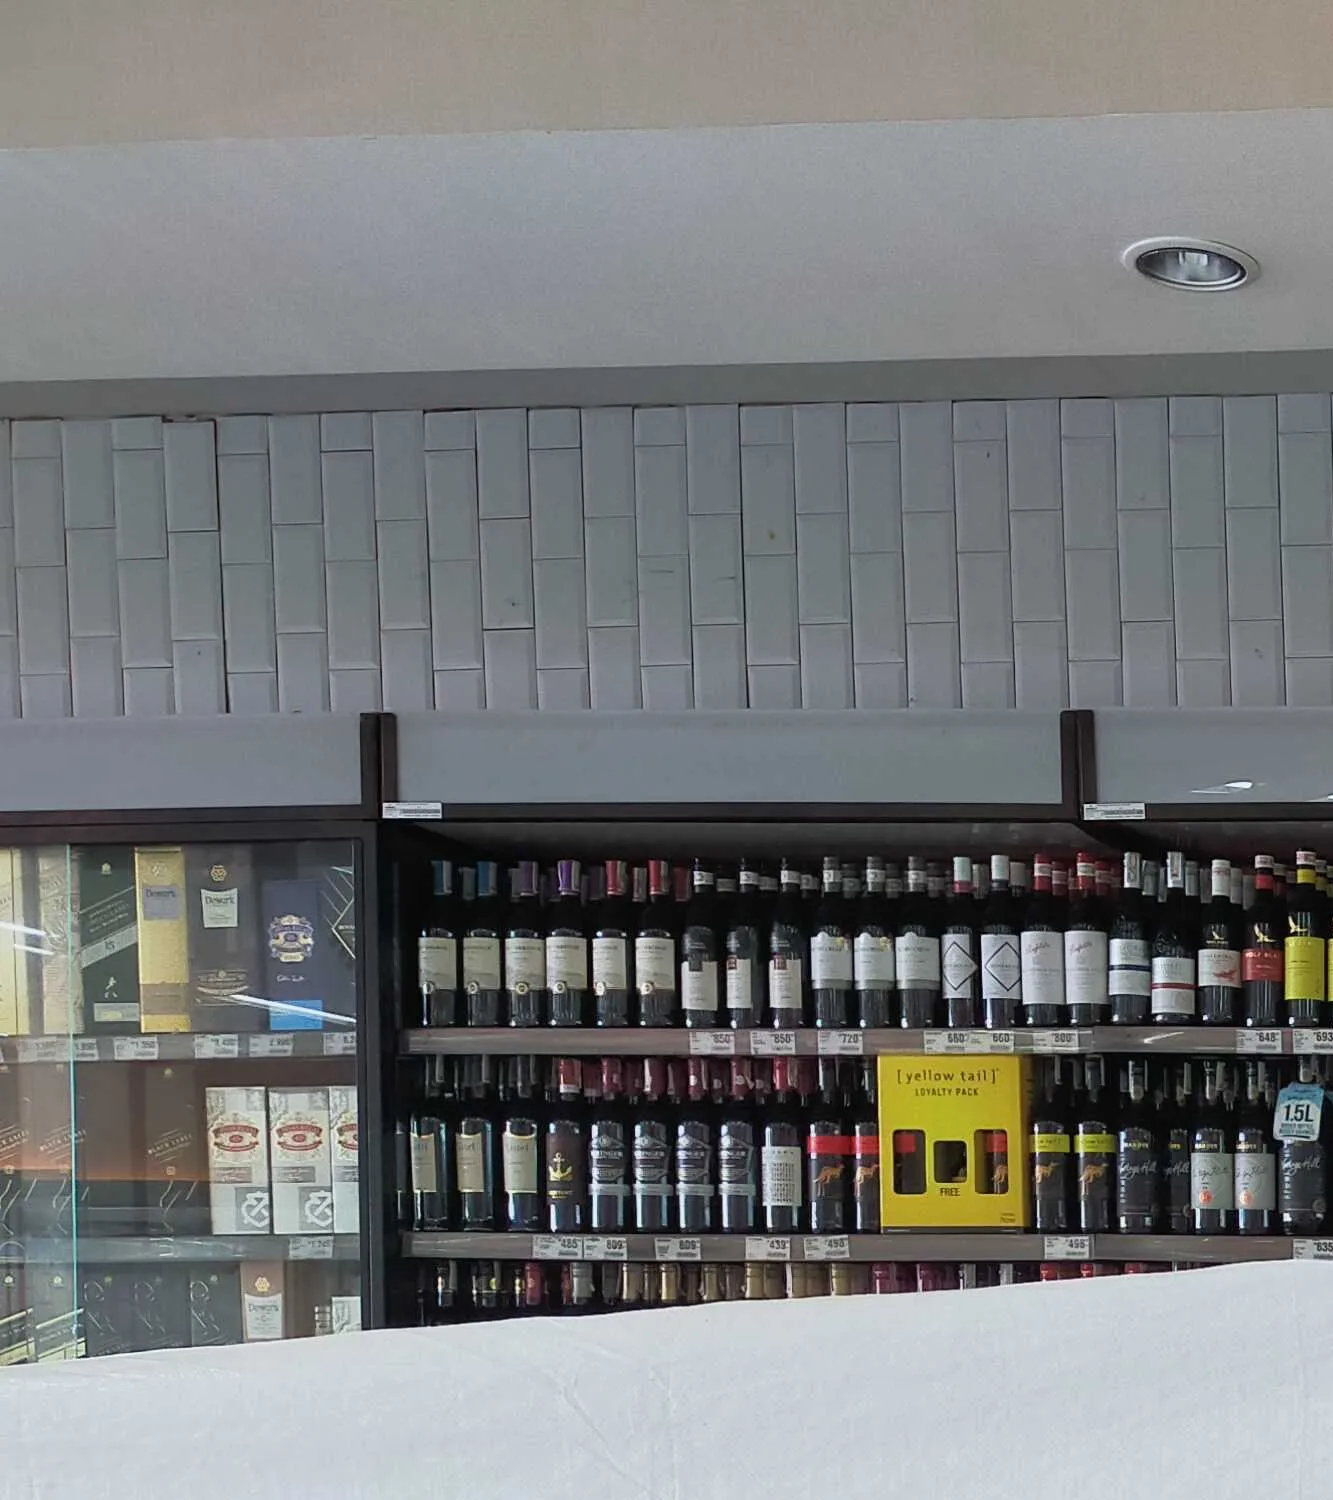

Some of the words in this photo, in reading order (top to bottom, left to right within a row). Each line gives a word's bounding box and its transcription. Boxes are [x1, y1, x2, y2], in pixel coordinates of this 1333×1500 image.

[773, 1033, 791, 1044] 850
[915, 1087, 952, 1096] LOYALTY
[955, 1087, 980, 1096] PACK
[1284, 1104, 1313, 1122] 1.5L
[939, 1187, 961, 1197] FREE
